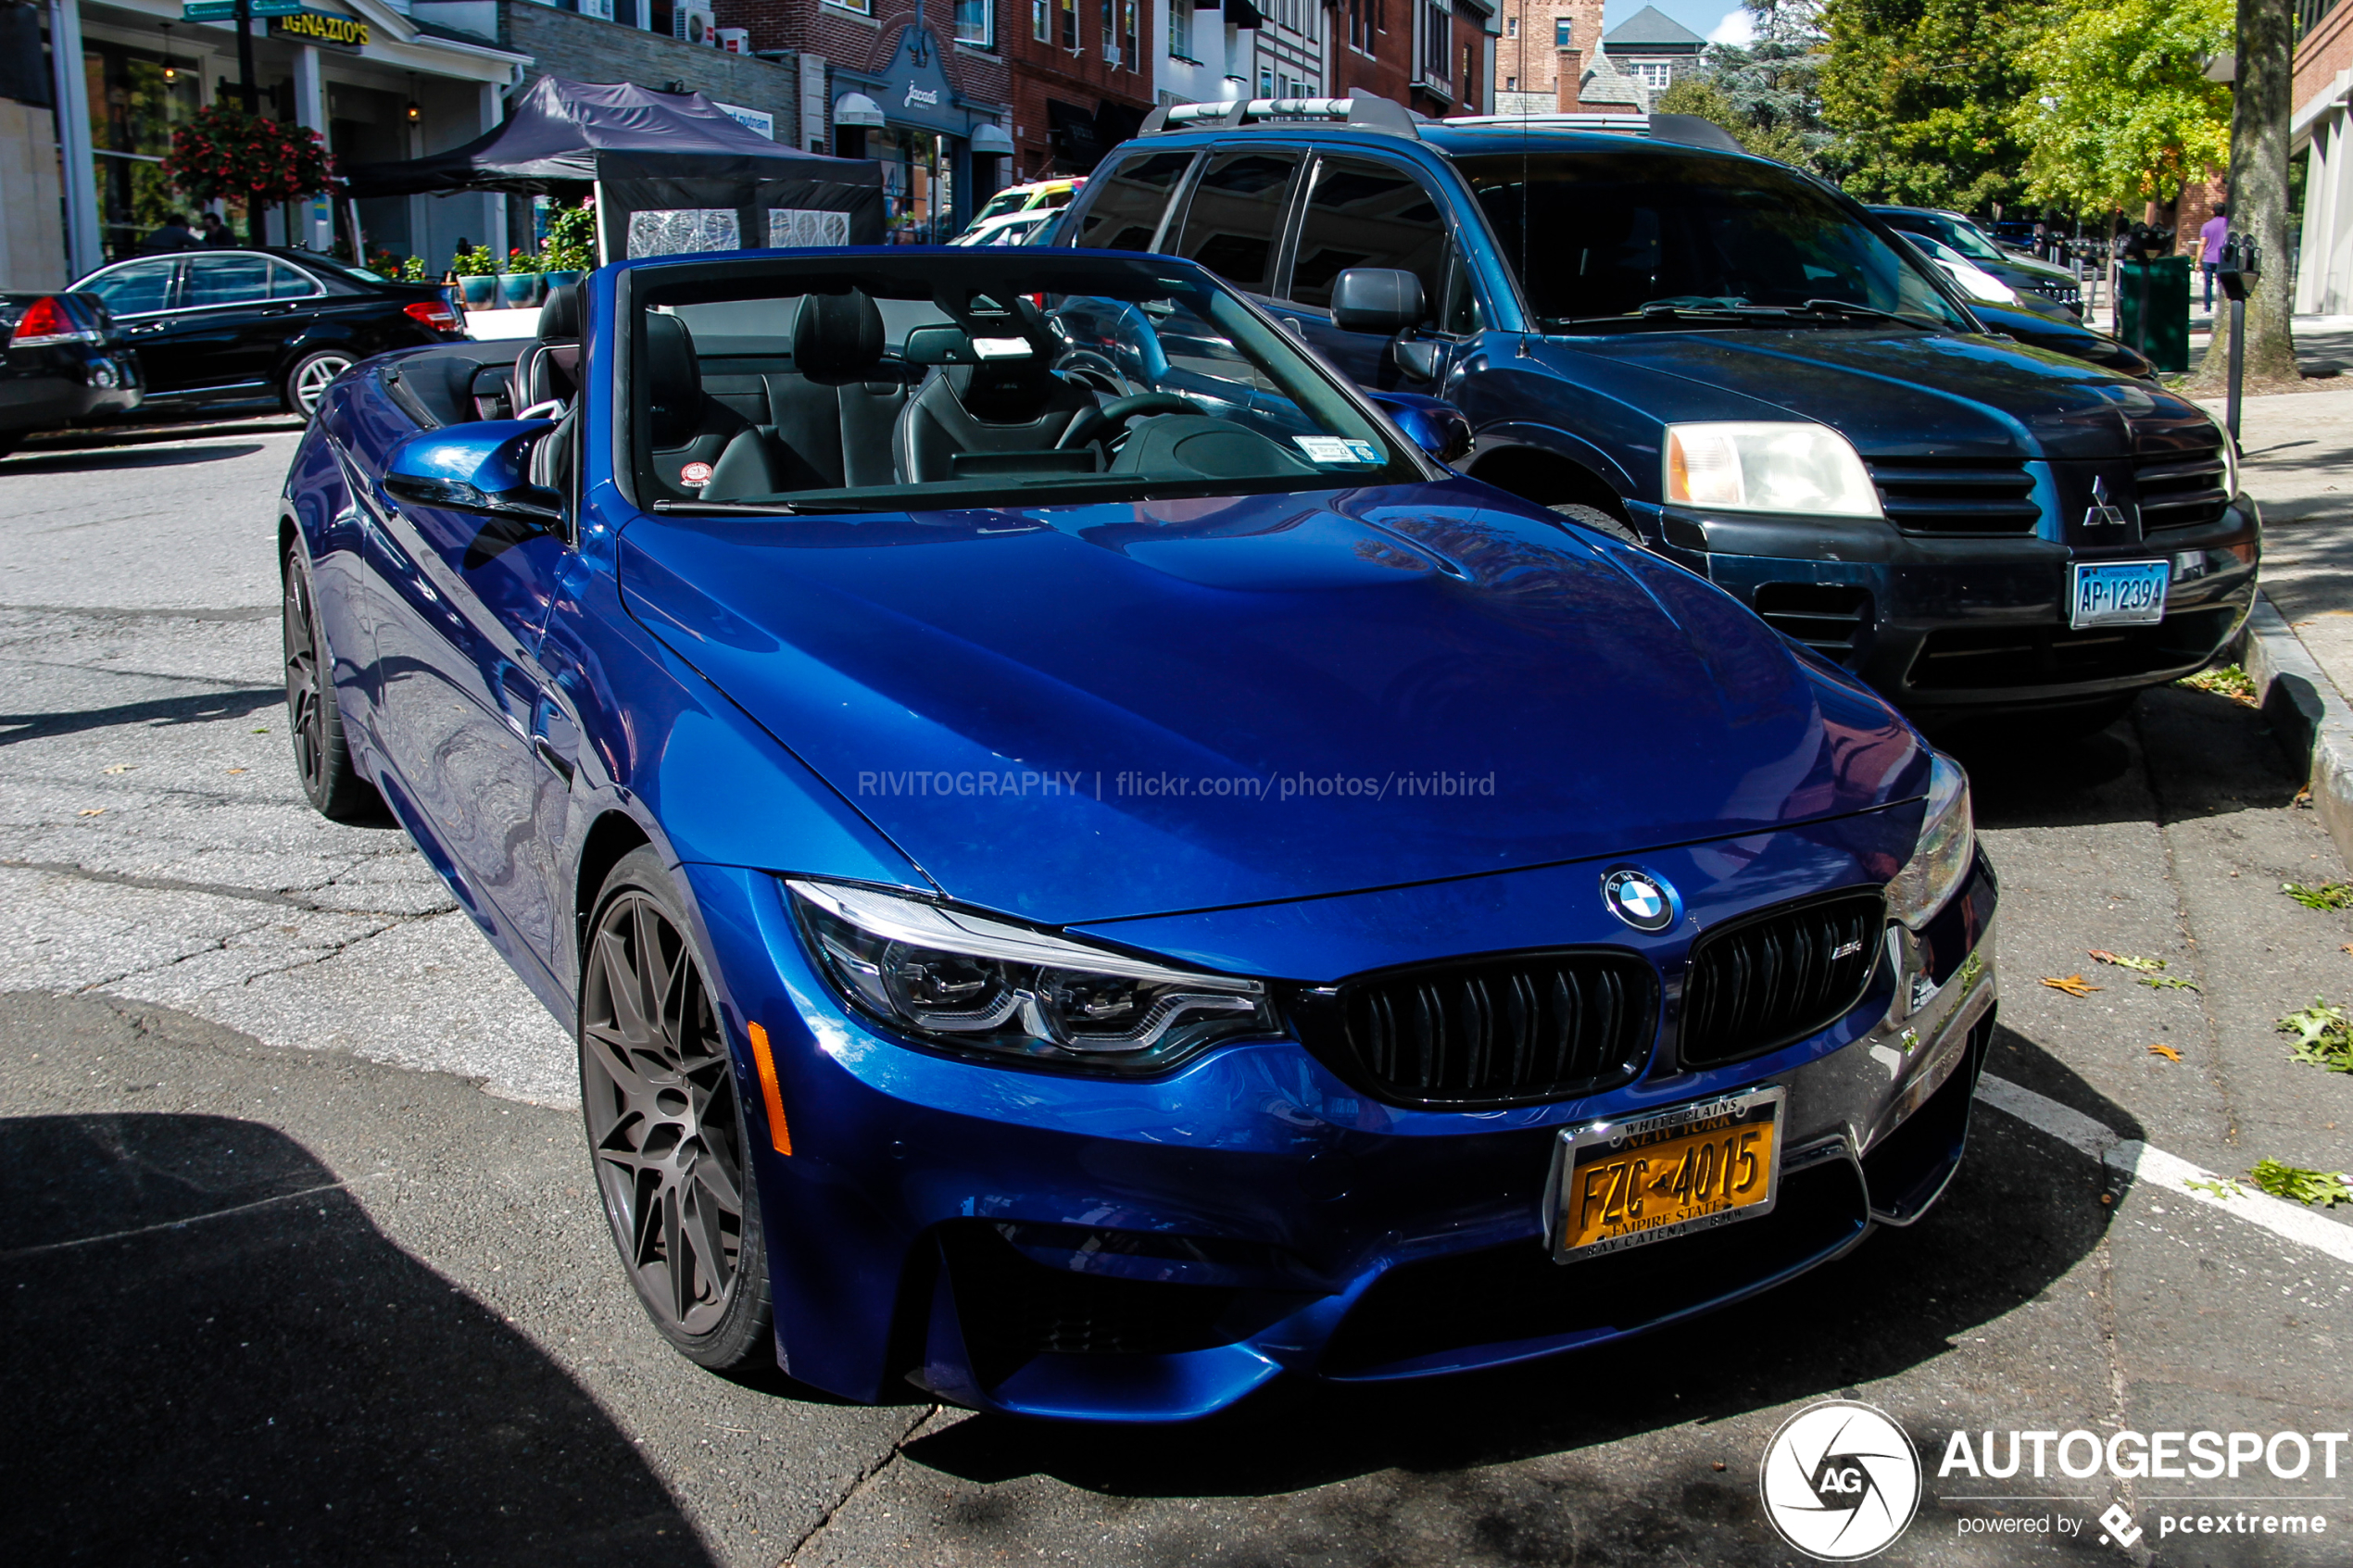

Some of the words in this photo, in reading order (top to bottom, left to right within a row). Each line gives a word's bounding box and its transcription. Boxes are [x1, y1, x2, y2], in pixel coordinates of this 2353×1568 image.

[281, 14, 370, 44] IGNAZIO'S
[2100, 569, 2143, 578] Connecticut
[1609, 872, 1656, 893] BMW
[1624, 1126, 1673, 1149] NEW
[1683, 1116, 1730, 1135] YORK
[1625, 1114, 1677, 1135] WHITE
[1683, 1099, 1738, 1123] PLAINS
[1671, 1131, 1758, 1204] 4015
[1587, 1241, 1620, 1257] RAY
[1625, 1223, 1687, 1247] CATENA
[1710, 1209, 1743, 1227] BMW
[1613, 1213, 1672, 1237] EMPIRE
[1676, 1199, 1721, 1221] STATE
